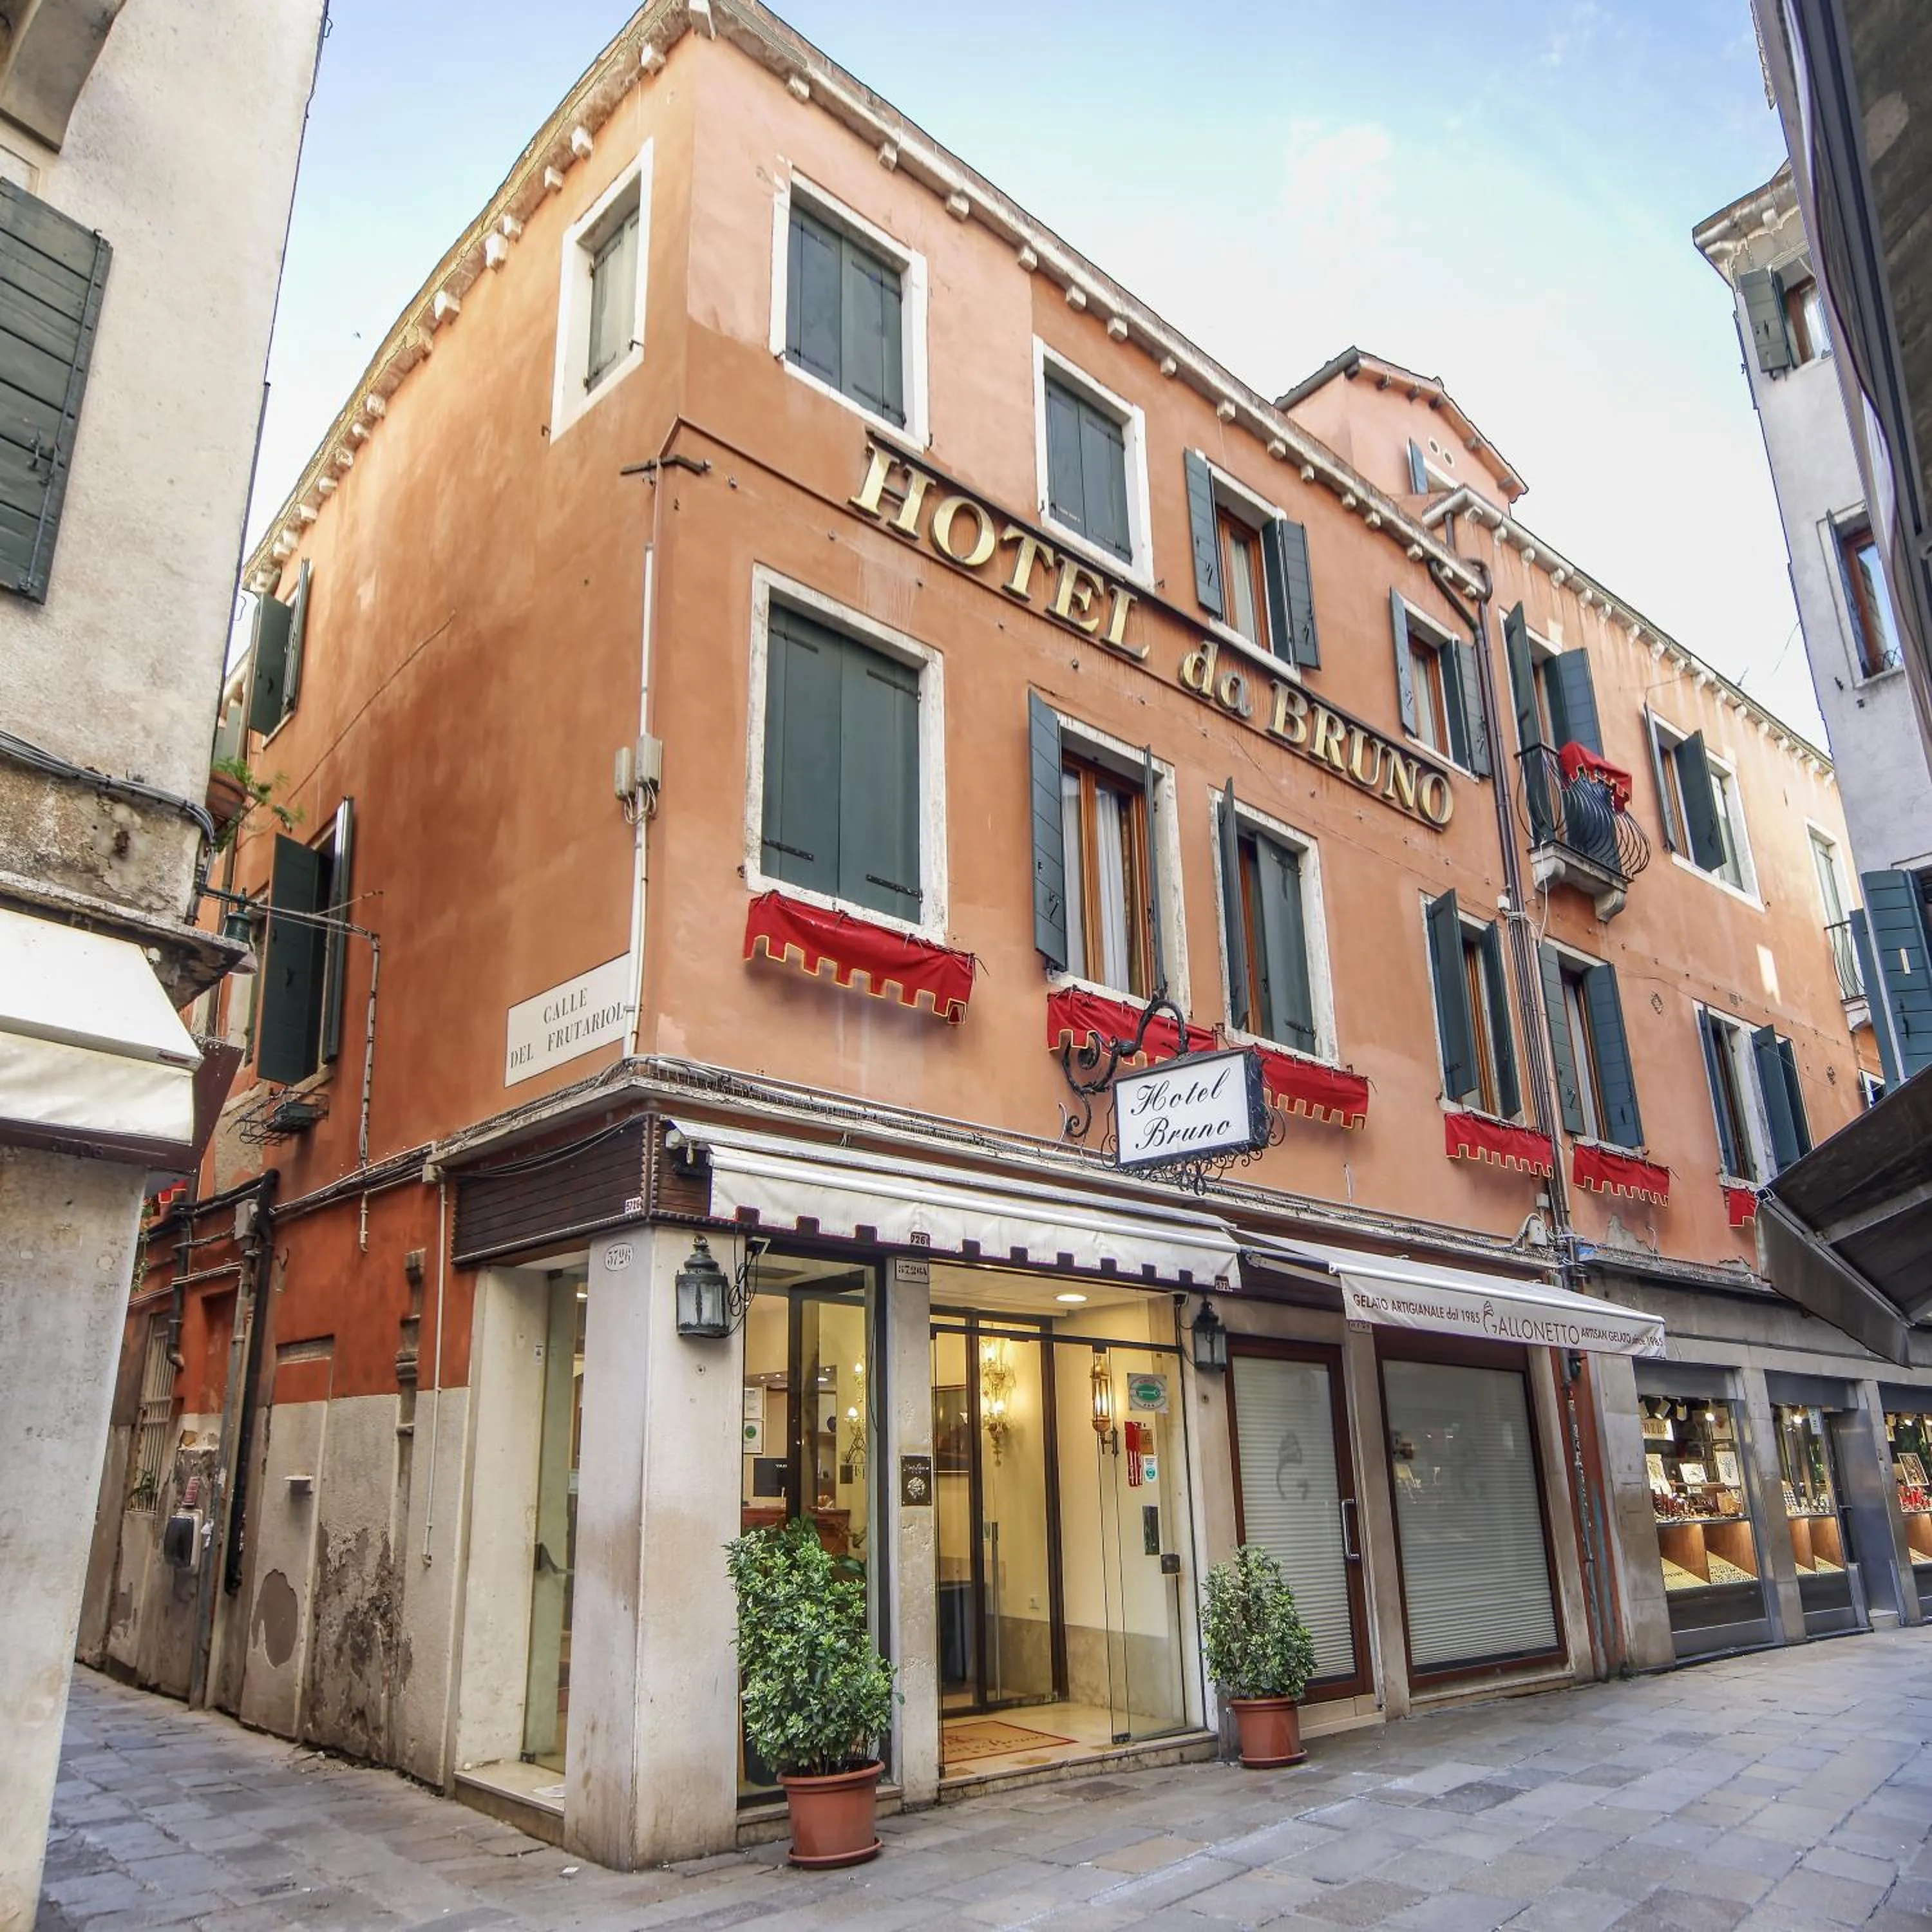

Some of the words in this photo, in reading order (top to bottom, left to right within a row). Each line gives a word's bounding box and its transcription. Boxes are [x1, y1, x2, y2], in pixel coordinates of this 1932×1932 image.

[848, 442, 1150, 661] HOTEL
[1179, 639, 1253, 719] da
[1265, 679, 1454, 826] BRUNO
[543, 987, 587, 1024] CALLE
[510, 1043, 534, 1068] DEL
[547, 1001, 624, 1052] FRUTARIOL
[1130, 1067, 1231, 1116] Hotel
[1135, 1115, 1231, 1151] Bruno
[1353, 1294, 1388, 1311] GELATO
[1391, 1300, 1444, 1319] ARTIGIANALE
[1446, 1307, 1459, 1320] dal
[1461, 1309, 1481, 1323] 1985
[1483, 1300, 1580, 1345] GALLONETTO
[1581, 1328, 1607, 1340] ARTISAN
[1608, 1331, 1632, 1344] GELATO
